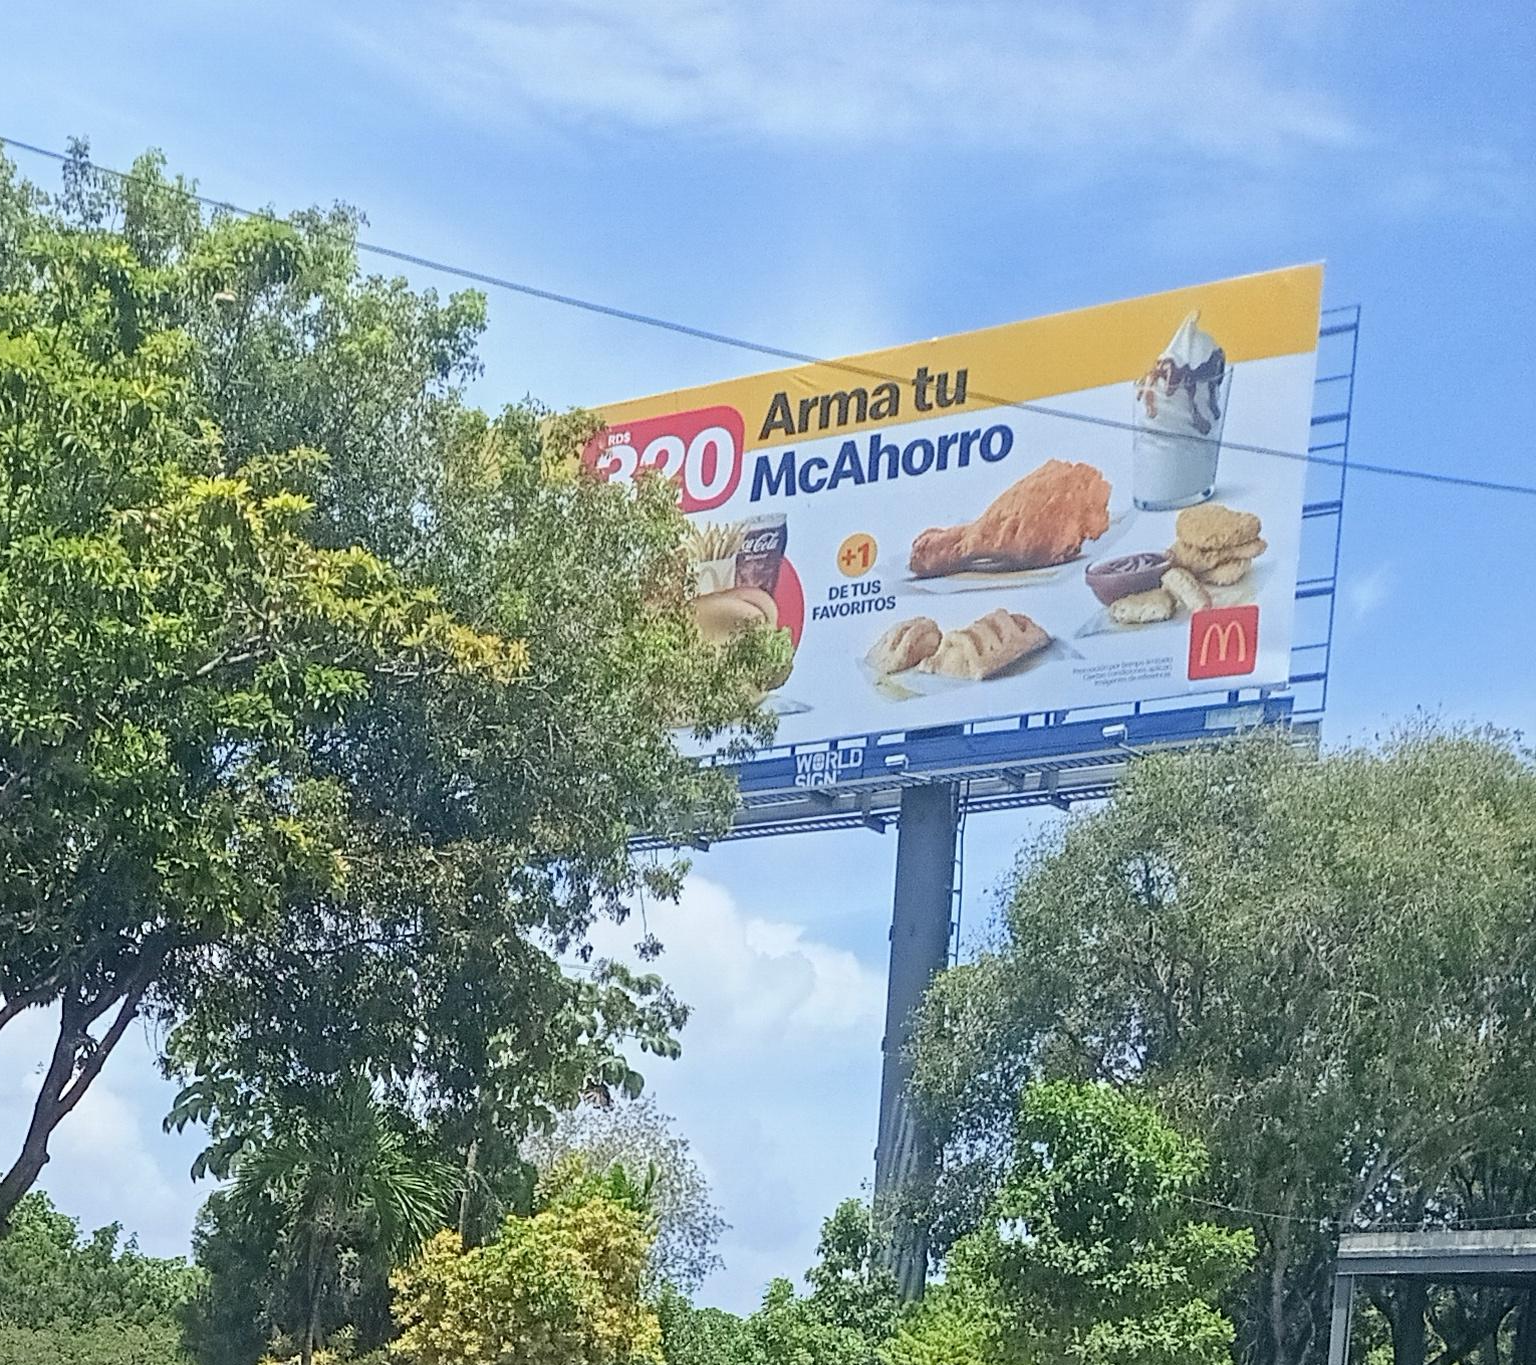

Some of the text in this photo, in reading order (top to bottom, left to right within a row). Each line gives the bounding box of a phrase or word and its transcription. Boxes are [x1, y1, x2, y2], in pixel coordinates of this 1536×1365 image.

[758, 366, 968, 441] Arma tu
[750, 424, 1014, 502] McAhorro
[841, 542, 869, 568] +1
[828, 579, 881, 601] DE TUS
[812, 595, 896, 621] FAVORITOS
[796, 748, 863, 774] WORLD
[795, 769, 837, 787] SIGN
